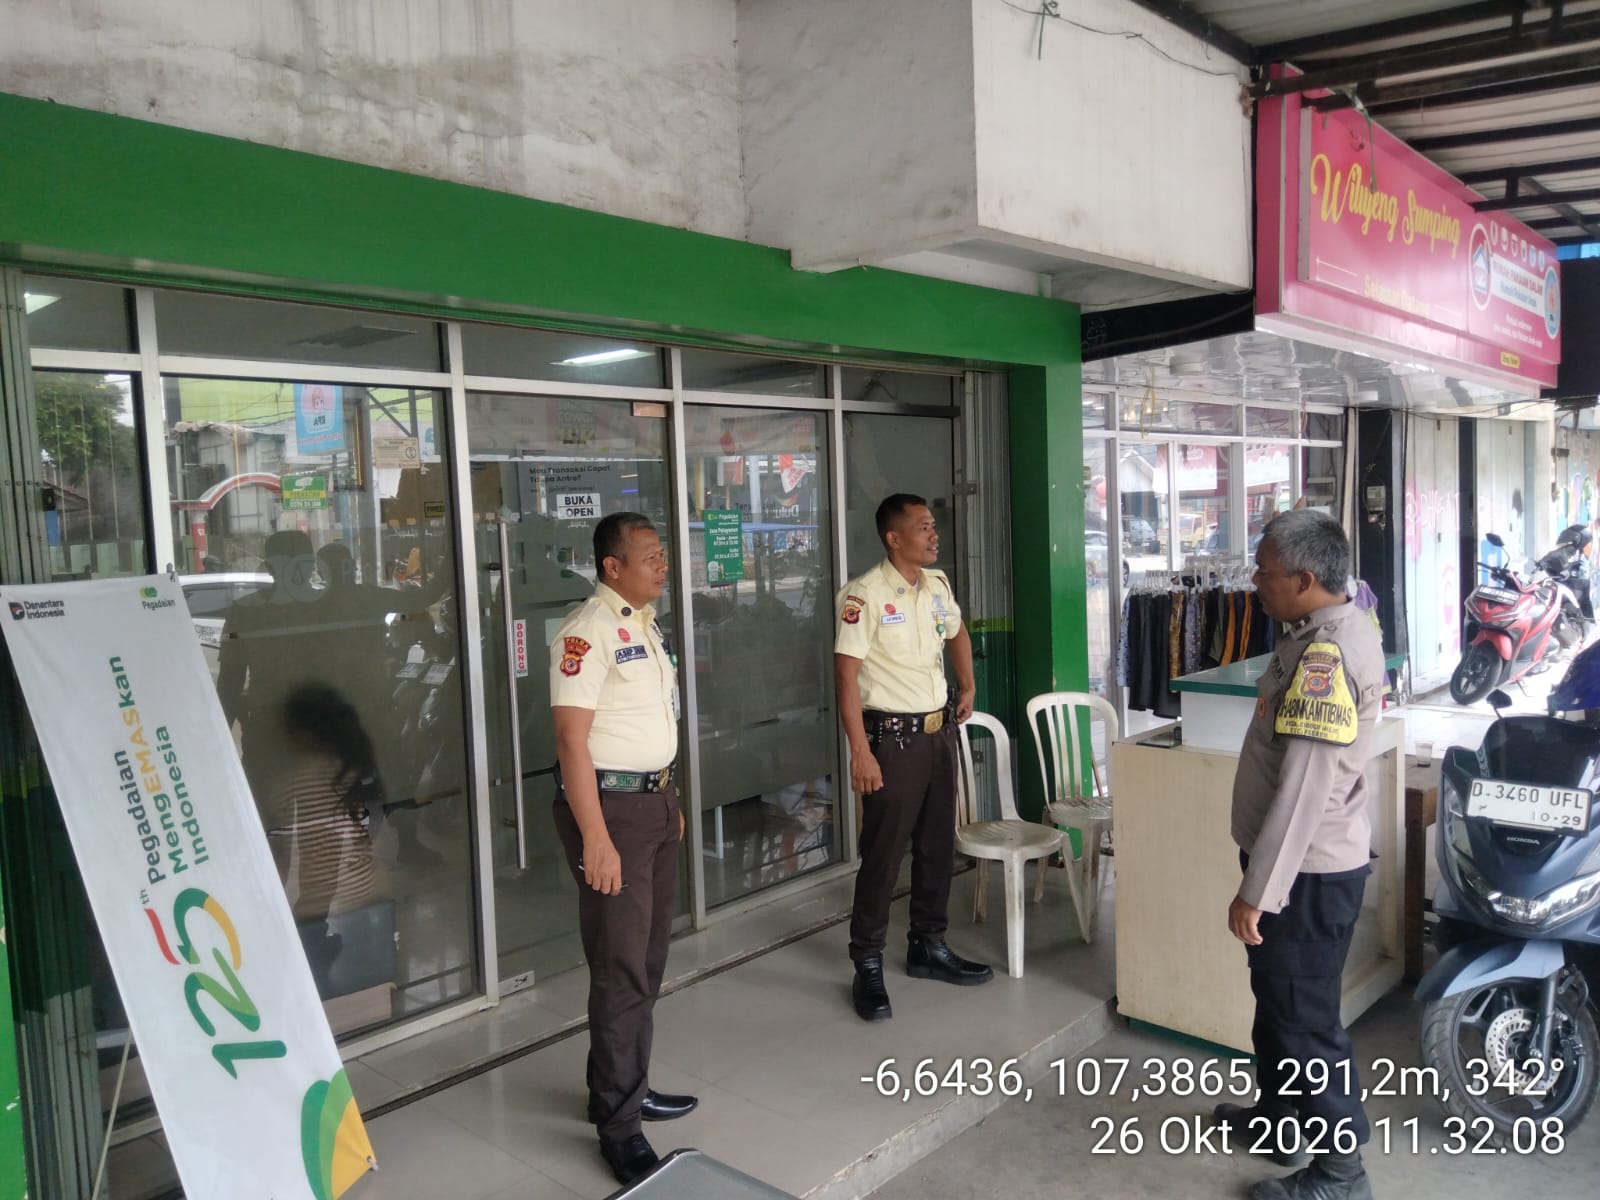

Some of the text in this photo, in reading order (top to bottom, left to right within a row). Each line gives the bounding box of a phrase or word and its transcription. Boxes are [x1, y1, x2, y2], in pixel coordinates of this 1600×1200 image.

[1310, 154, 1461, 260] Wilujeng Sumping
[530, 475, 555, 484] Tapa
[564, 495, 594, 506] BUKA
[565, 507, 594, 517] OPEN
[24, 600, 65, 610] Danantara
[141, 599, 176, 611] Pegadaian
[26, 609, 65, 620] Indonesia
[516, 623, 525, 670] DORONG
[108, 656, 189, 875] MengEMASkan
[155, 725, 210, 866] Indonesia
[1495, 784, 1540, 803] 3460
[1550, 791, 1584, 809] UFL
[114, 750, 167, 884] Pegadaian
[1506, 836, 1541, 845] HONDA
[144, 888, 287, 1080] 125
